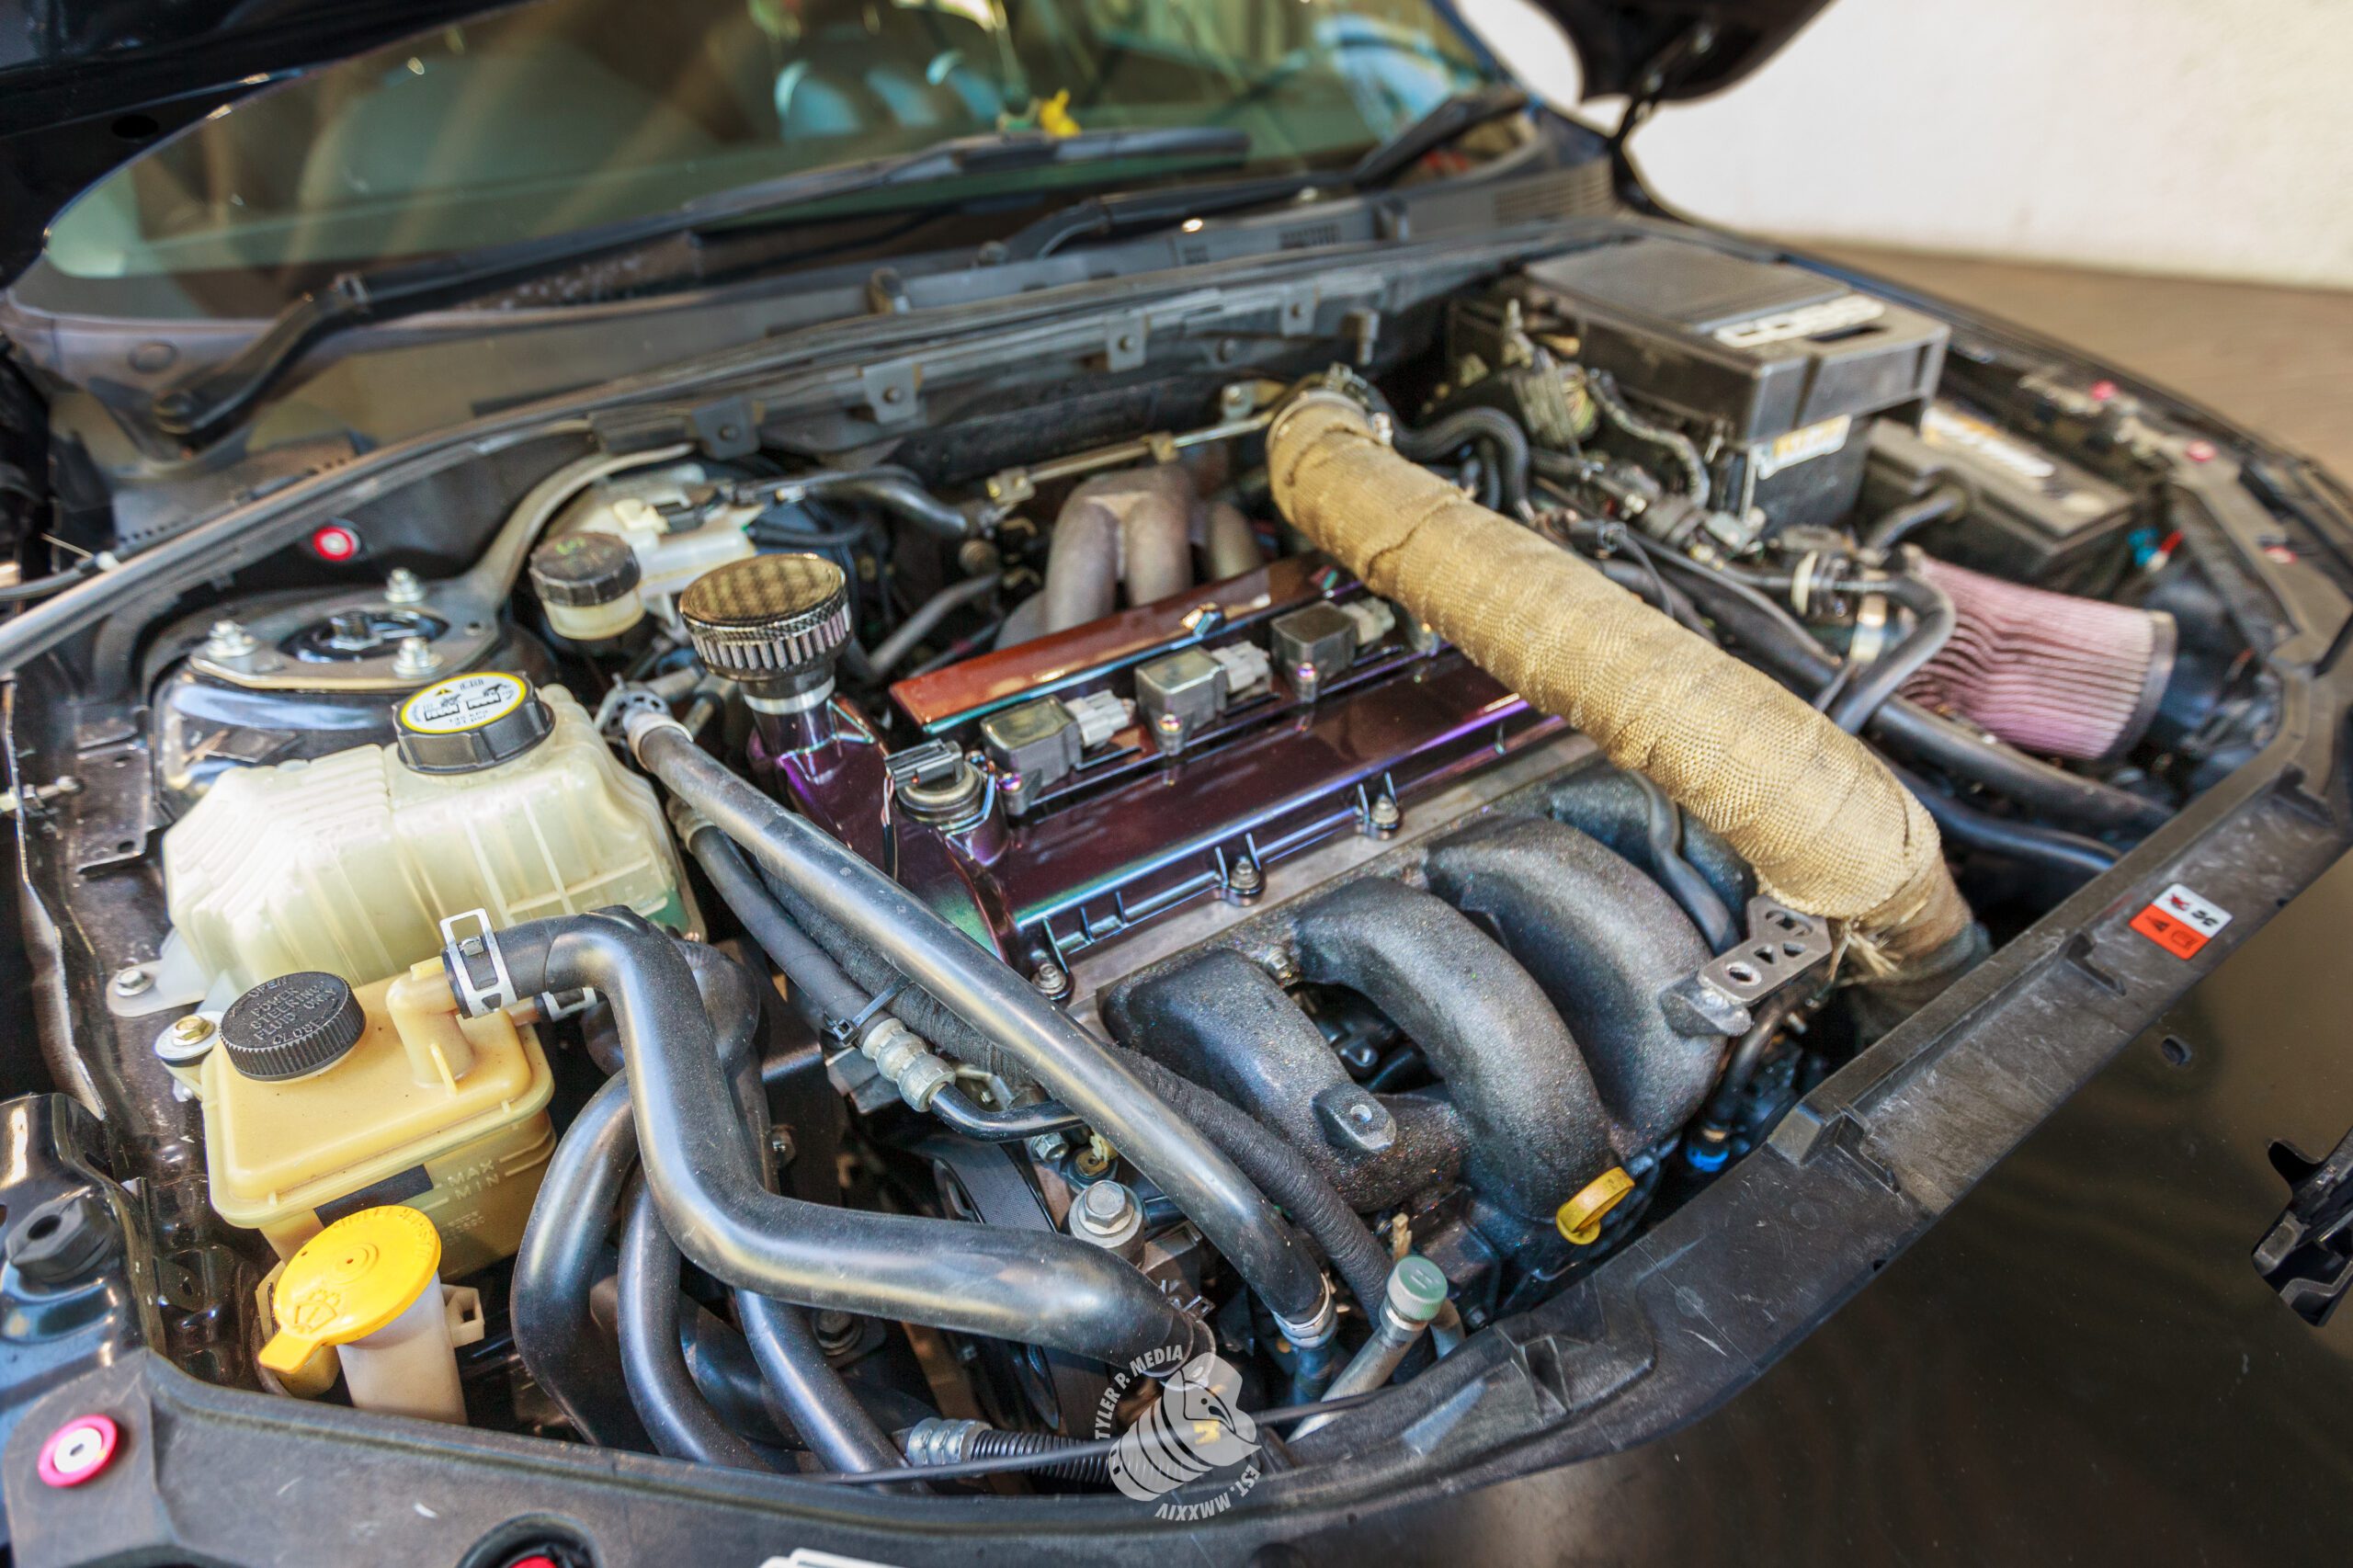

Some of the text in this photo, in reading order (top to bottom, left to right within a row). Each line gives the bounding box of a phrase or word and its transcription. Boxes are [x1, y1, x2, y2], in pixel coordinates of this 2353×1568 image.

[247, 976, 288, 998] OPEN
[249, 983, 322, 1029] STEERING
[250, 987, 299, 1017] POWER
[253, 1012, 297, 1040] FLUID
[272, 1020, 321, 1045] CLOSE
[447, 1160, 494, 1187] MAX
[454, 1173, 500, 1200] MIN
